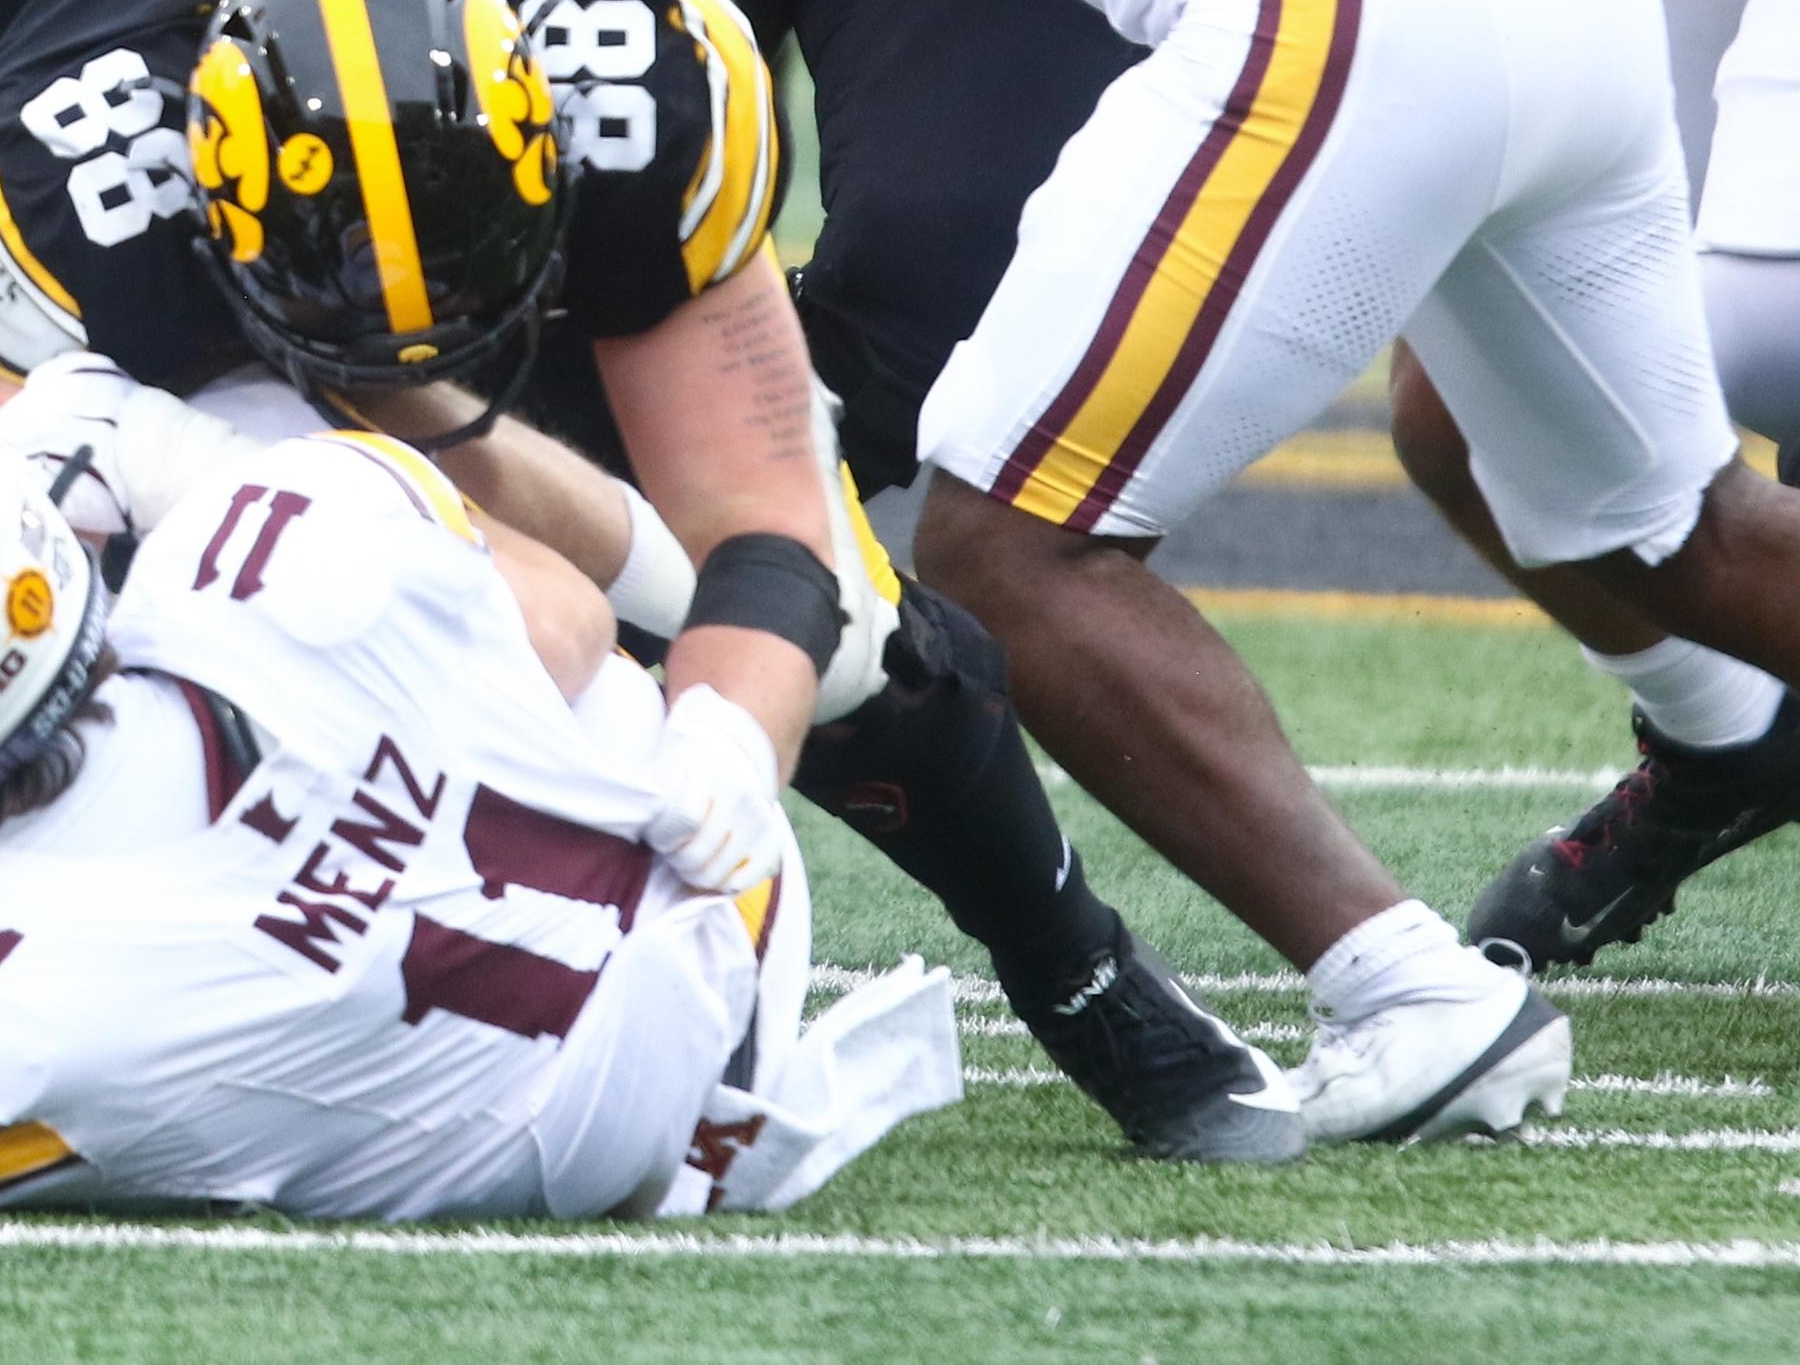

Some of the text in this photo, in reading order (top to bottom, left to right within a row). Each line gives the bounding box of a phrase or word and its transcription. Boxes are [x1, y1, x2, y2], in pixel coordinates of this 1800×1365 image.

[20, 47, 199, 247] 88
[192, 484, 313, 601] 11
[254, 733, 448, 975] MENZ
[401, 782, 653, 1048] 11
